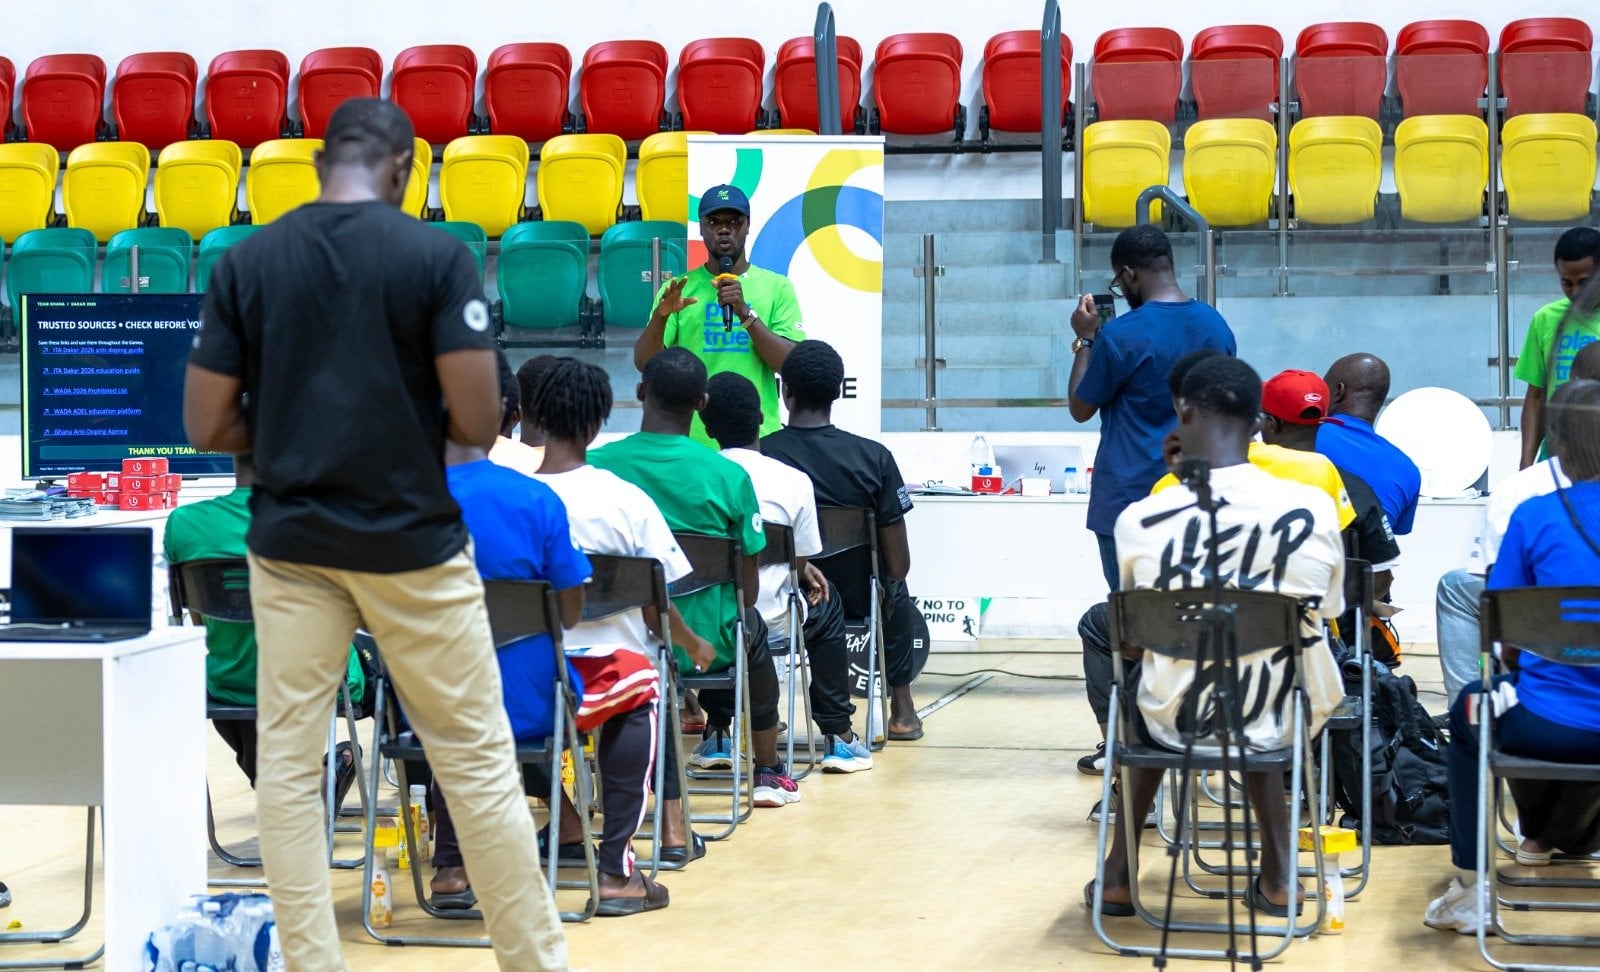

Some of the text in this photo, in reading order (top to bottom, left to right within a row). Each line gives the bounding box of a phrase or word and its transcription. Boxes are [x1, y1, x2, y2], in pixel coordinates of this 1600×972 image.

[37, 321, 75, 330] TRUSTED
[78, 321, 116, 330] SOURCES
[125, 321, 152, 330] CHECK
[154, 321, 186, 330] BEFORE
[704, 329, 749, 345] true
[1558, 330, 1597, 352] pla
[157, 447, 173, 455] YOU
[175, 447, 196, 455] TEAM
[1153, 508, 1314, 592] HELP
[923, 600, 943, 610] NO
[947, 600, 965, 610] TO
[924, 613, 956, 623] PING
